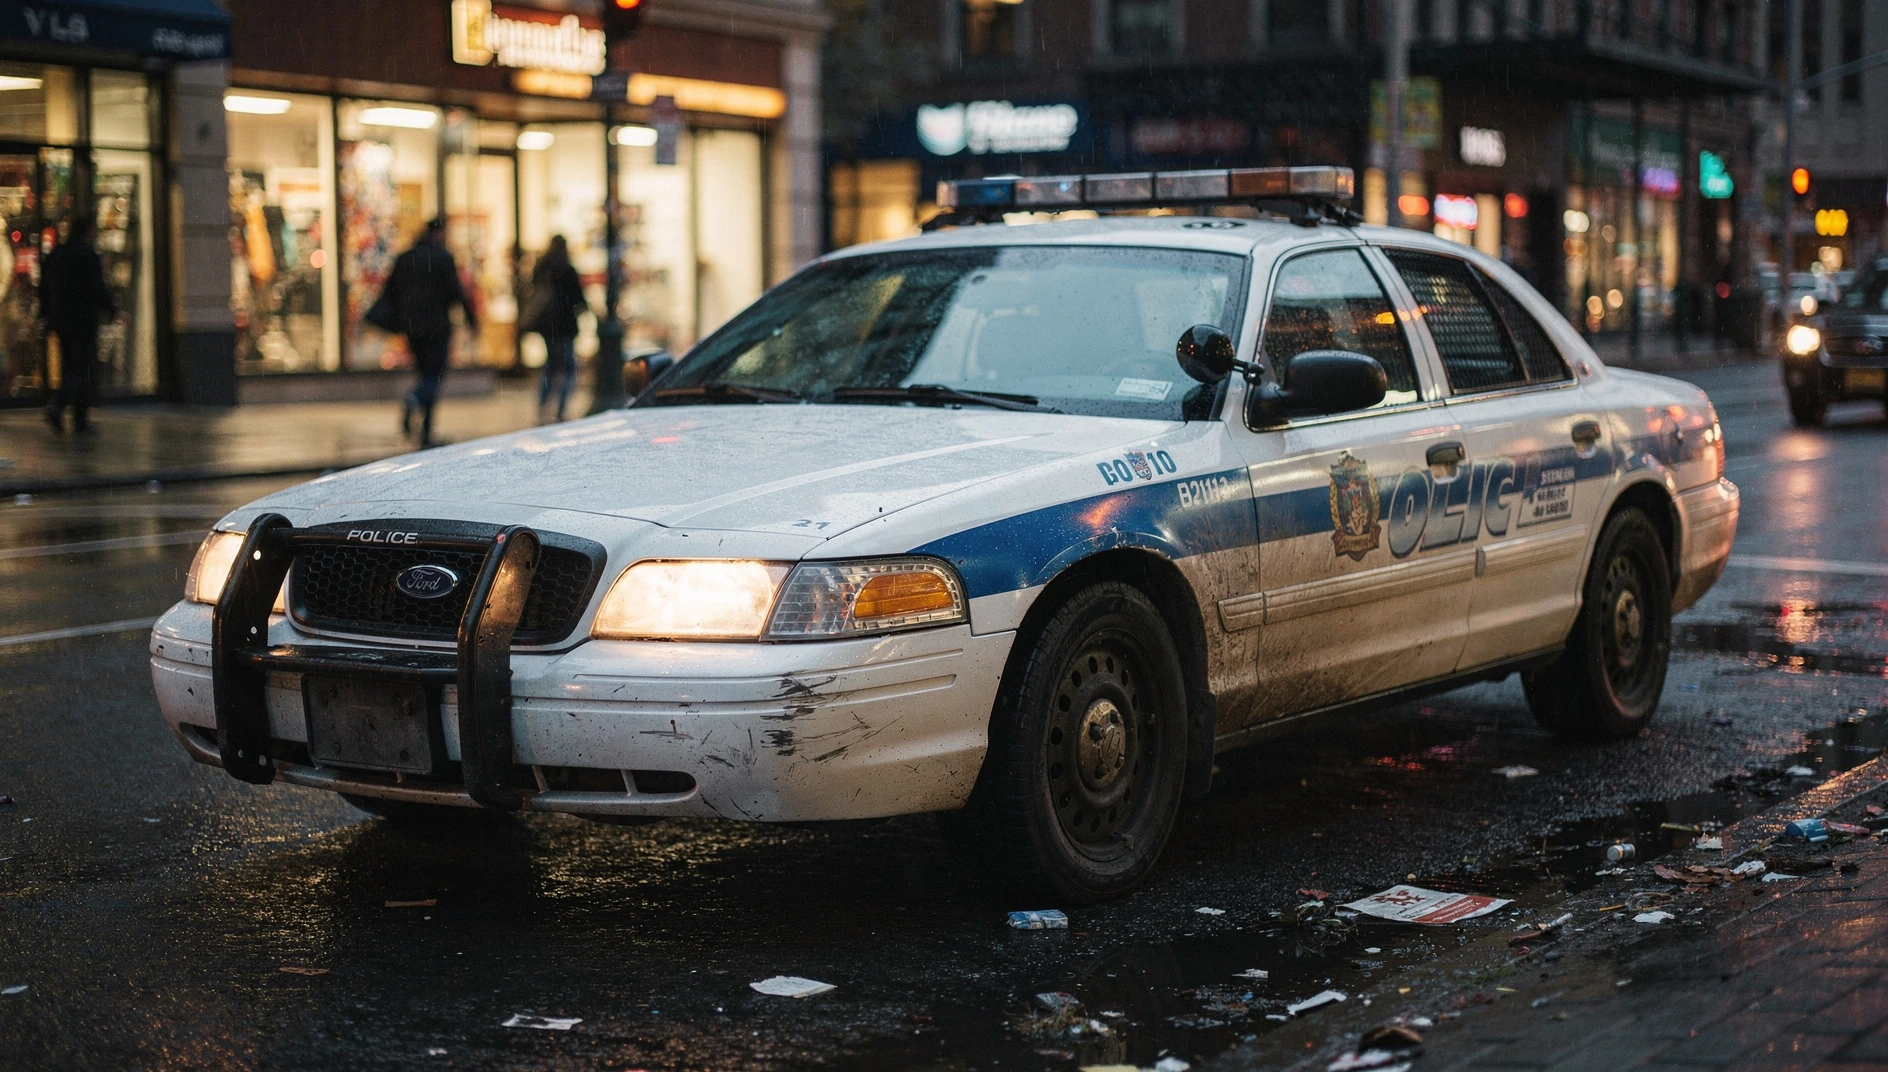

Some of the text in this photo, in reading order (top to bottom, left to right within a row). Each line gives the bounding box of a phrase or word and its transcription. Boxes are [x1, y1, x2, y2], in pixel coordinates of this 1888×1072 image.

[1146, 450, 1177, 476] 10
[346, 529, 419, 545] POLICE
[406, 568, 442, 591] Ford
